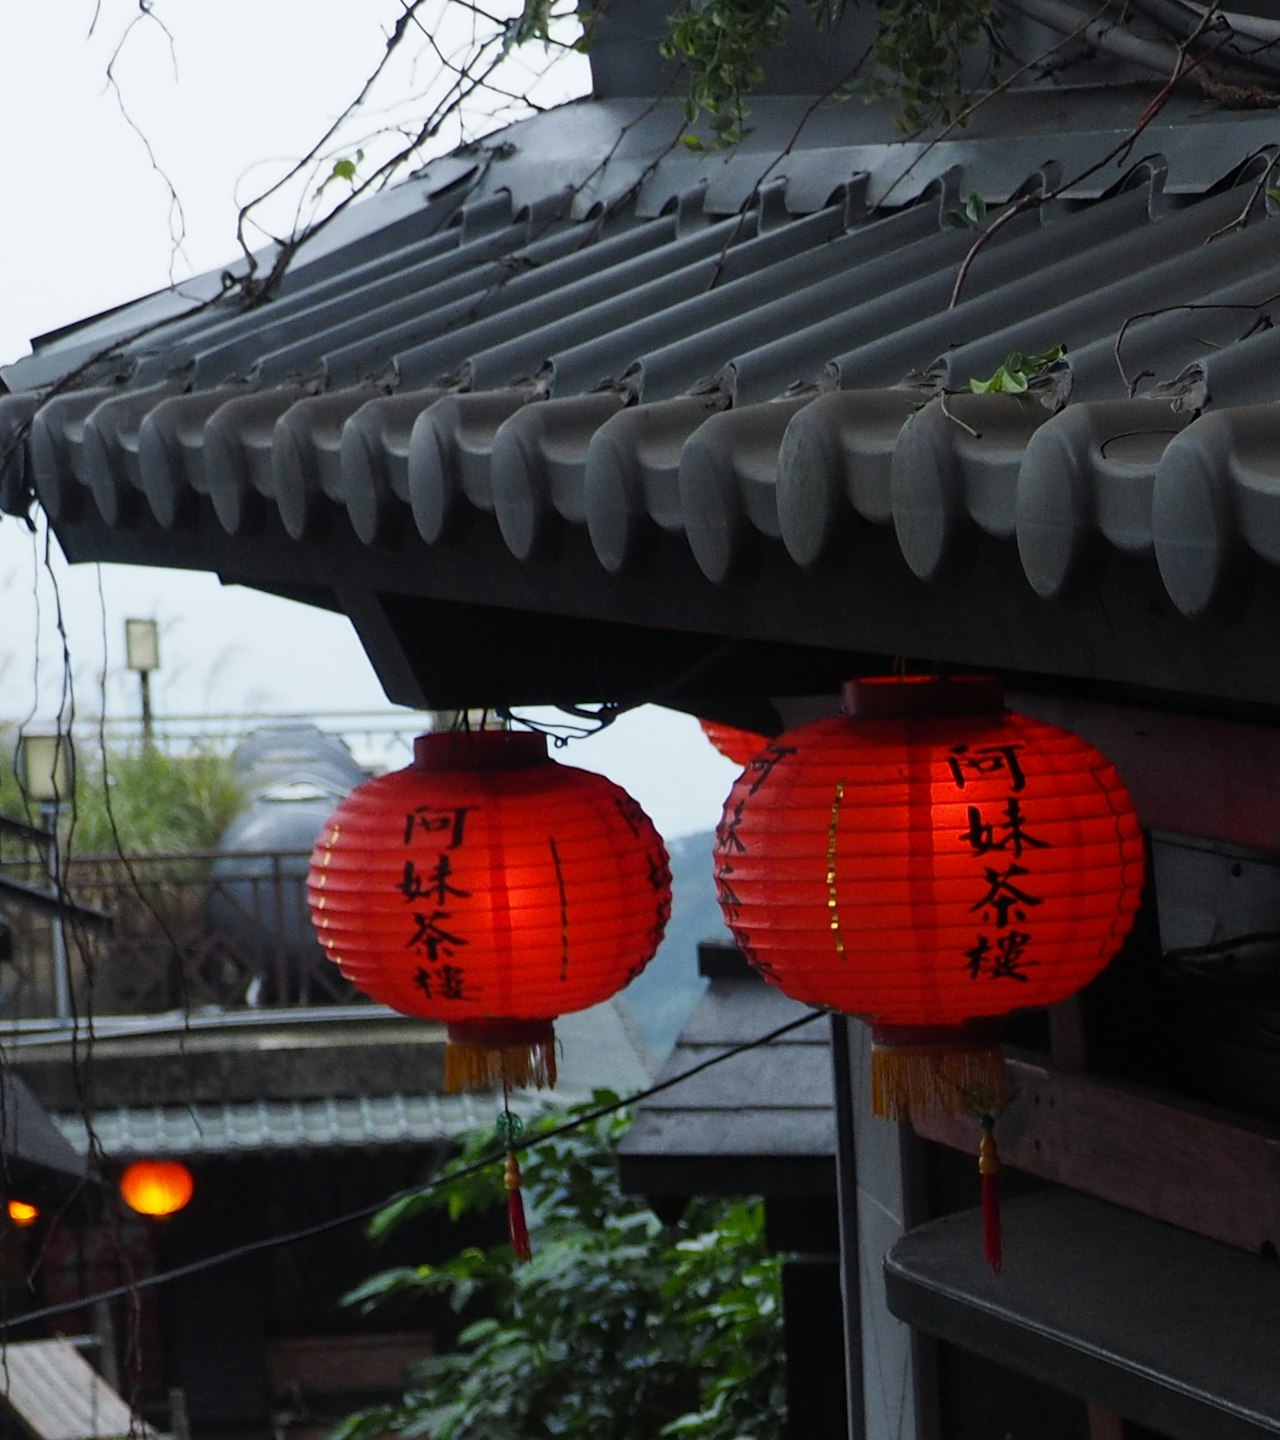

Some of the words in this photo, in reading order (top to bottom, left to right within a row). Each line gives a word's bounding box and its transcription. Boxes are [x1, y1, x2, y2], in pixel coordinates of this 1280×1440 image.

[397, 804, 481, 1003] 阿妹茶樓
[948, 743, 1053, 983] 阿妹茶樓
